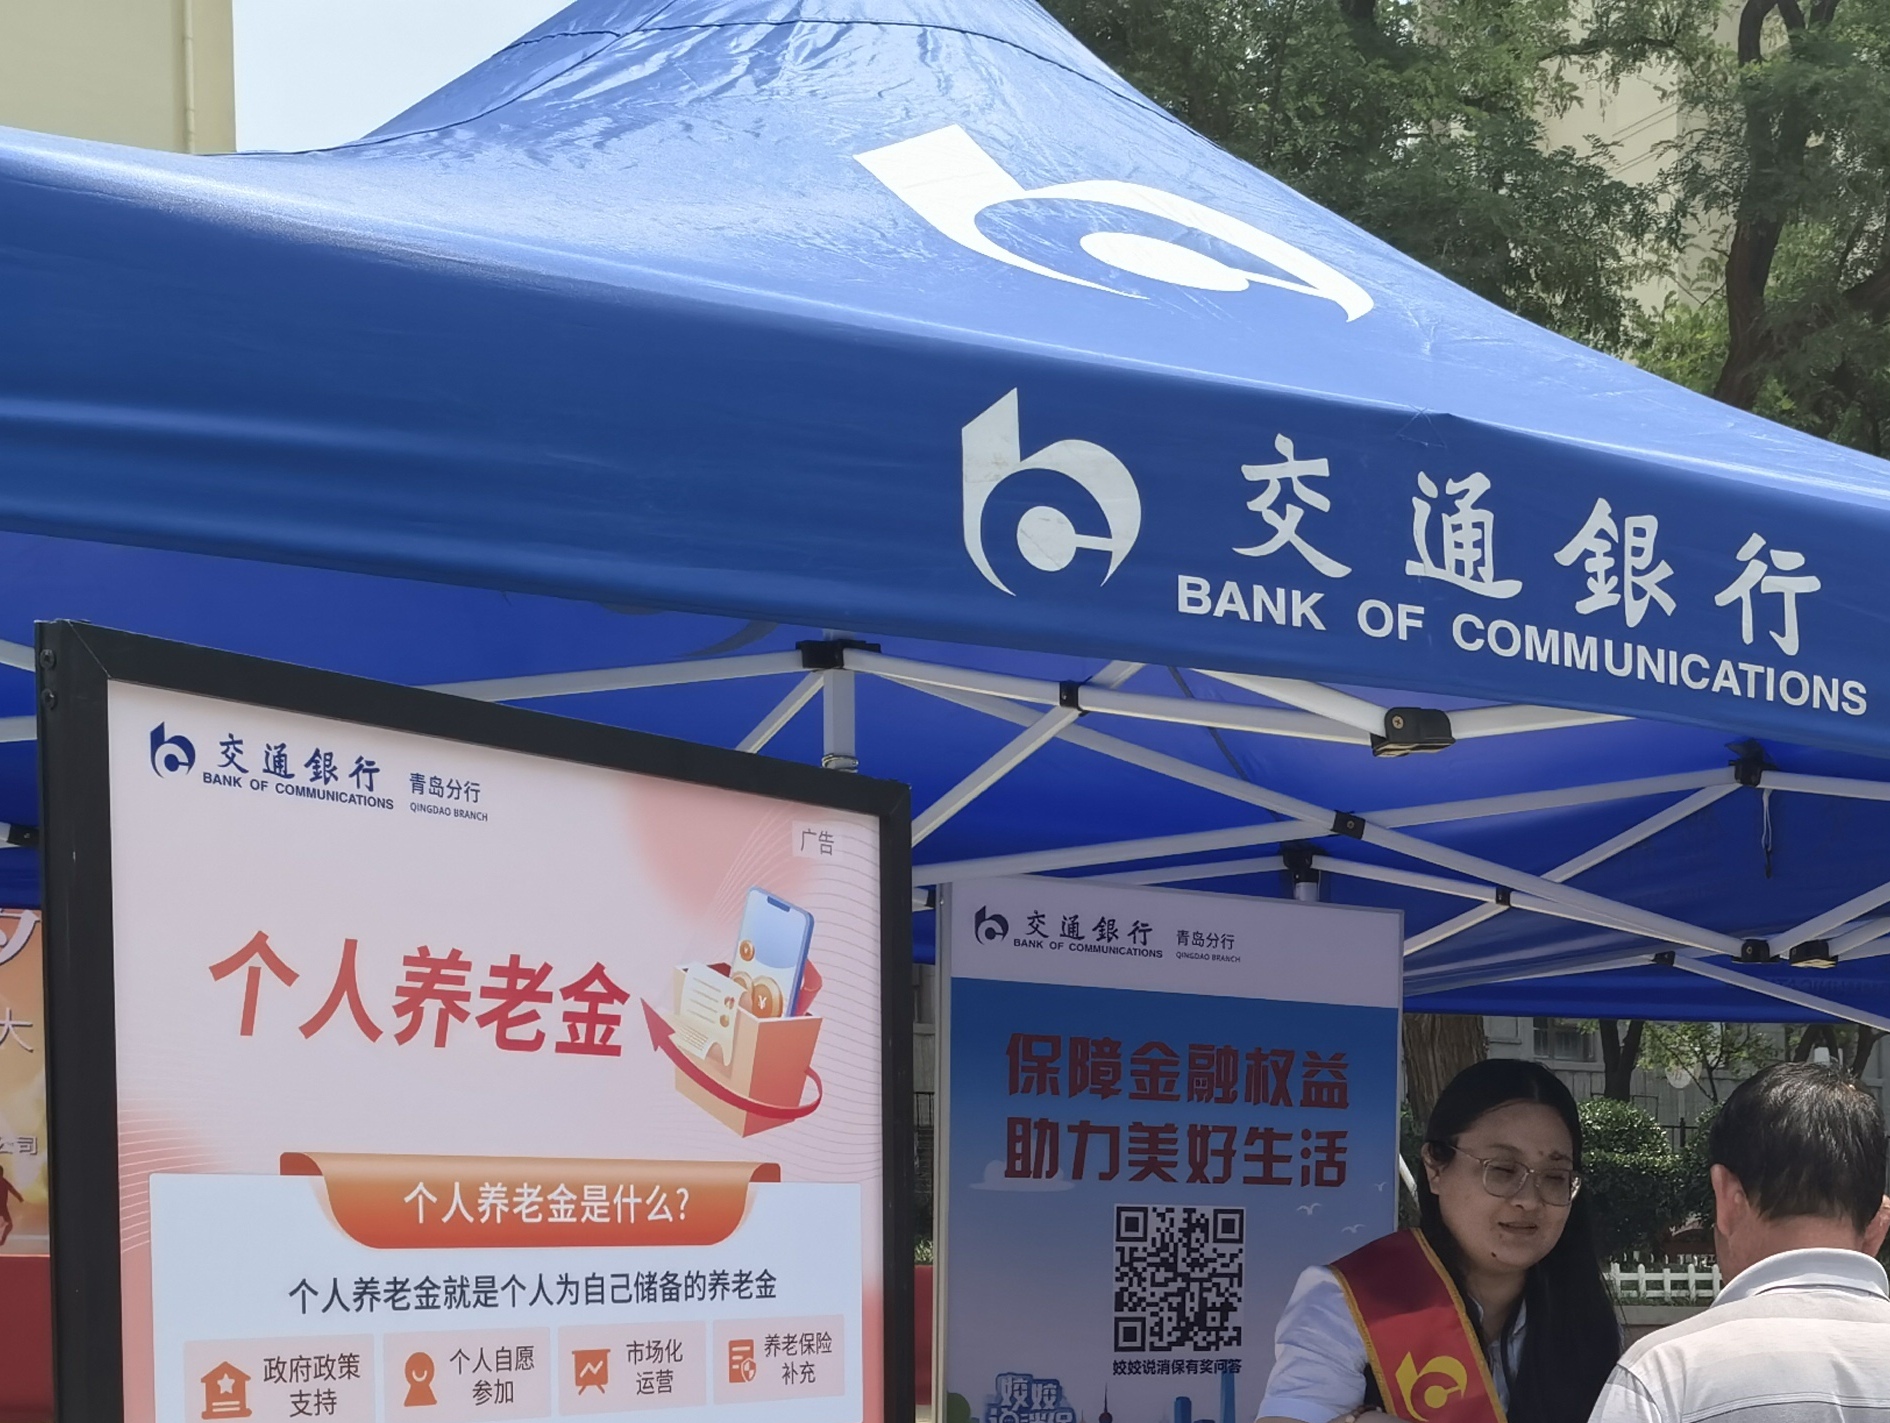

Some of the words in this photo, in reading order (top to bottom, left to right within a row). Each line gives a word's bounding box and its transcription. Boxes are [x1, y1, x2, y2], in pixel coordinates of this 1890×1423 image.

[1232, 434, 1821, 657] 交通銀行
[1177, 574, 1326, 631] BANK
[1357, 600, 1424, 642] OF
[1452, 613, 1868, 717] COMMUNICATIONS
[217, 732, 381, 792] 交通銀行
[408, 772, 481, 804] 青岛分行
[202, 772, 242, 789] BANK
[250, 779, 268, 792] OF
[275, 782, 394, 810] COMMUNICATIONS
[409, 802, 452, 817] QINGDAO
[453, 808, 489, 822] BRANCH
[800, 828, 836, 857] 广告
[1025, 910, 1154, 947] 交通銀行
[1176, 929, 1236, 951] 青岛分行
[1013, 938, 1043, 950] BANK
[1049, 941, 1064, 950] OF
[1068, 942, 1163, 959] COMMUNICATIONS
[1175, 951, 1211, 962] QINGDAO
[1212, 953, 1241, 963] BRANCH
[210, 930, 631, 1058] 个人养老金
[1005, 1032, 1349, 1109] 保障金融权益
[1004, 1116, 1349, 1188] 助力美好生活
[288, 1268, 778, 1315] 个人养老金就是个人为自己储备的养老金
[625, 1339, 684, 1365] 市场化
[764, 1331, 833, 1358] 养老保险
[263, 1352, 361, 1385] 政府政策
[449, 1346, 535, 1376] 个人自愿
[781, 1360, 817, 1386] 补充
[1112, 1358, 1242, 1376] 姣姣说消保有奖问答
[471, 1378, 515, 1405] 参加
[635, 1369, 675, 1395] 运营
[1000, 1375, 1060, 1410] 姣姣
[288, 1389, 338, 1418] 支持
